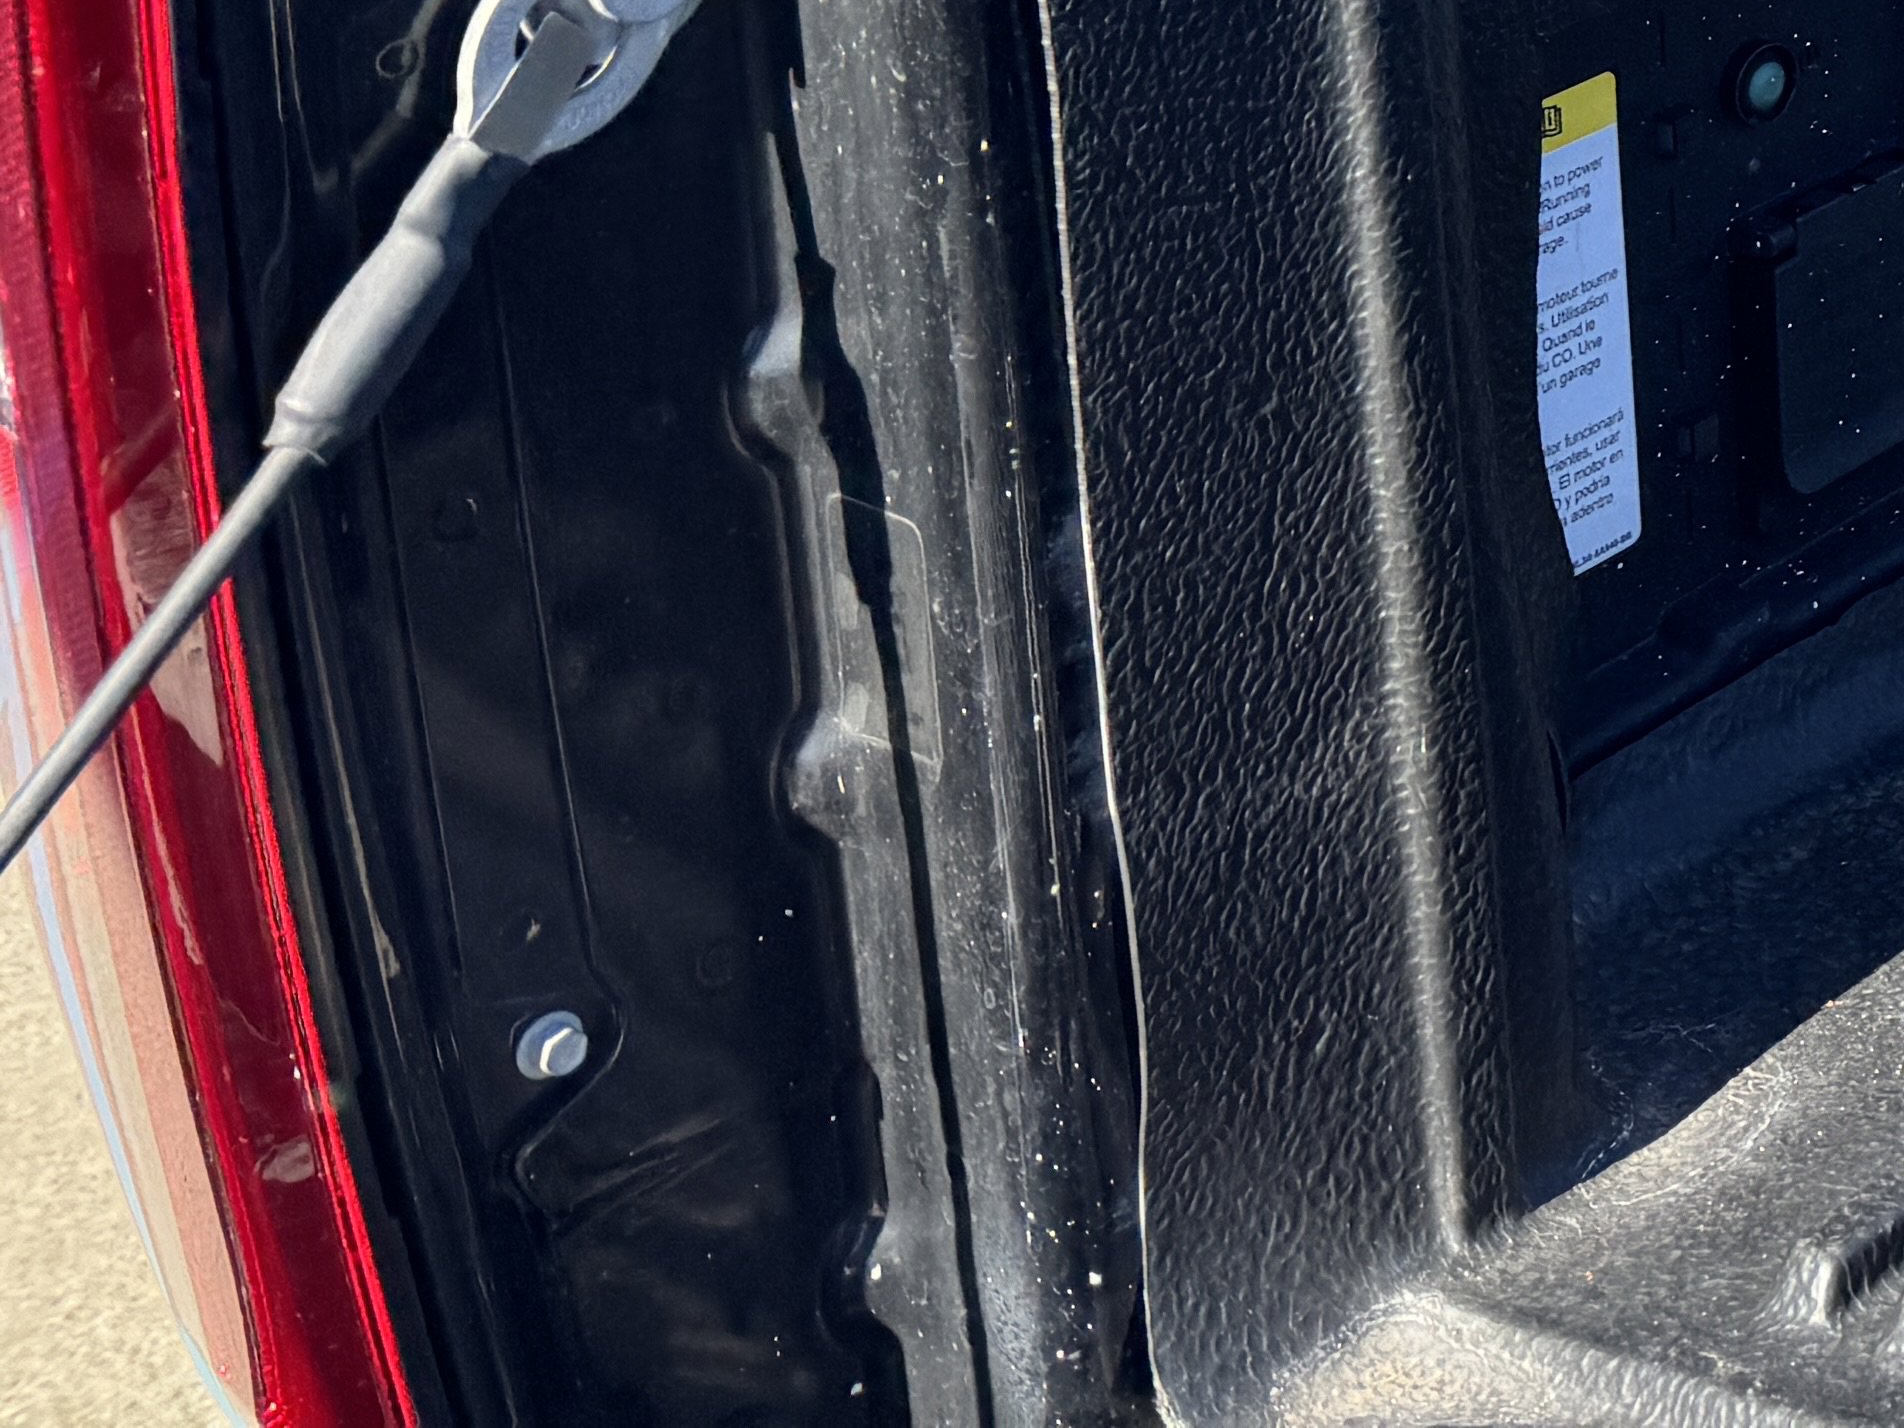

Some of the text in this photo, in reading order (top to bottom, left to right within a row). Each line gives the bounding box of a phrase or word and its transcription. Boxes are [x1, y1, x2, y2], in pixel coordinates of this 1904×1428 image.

[1554, 174, 1565, 188] to
[1567, 155, 1604, 185] power
[1541, 183, 1591, 213] Running
[1556, 203, 1592, 227] cause
[1581, 268, 1618, 294] tourne
[1551, 292, 1609, 328] Utilisation
[1542, 322, 1583, 352] Quand
[1552, 349, 1576, 369] CO.
[1578, 336, 1603, 356] Une
[1559, 357, 1601, 389] garage
[1565, 408, 1624, 449] funcionará
[1595, 430, 1621, 451] usar
[1559, 448, 1624, 490] El motor en
[1575, 474, 1611, 506] podría
